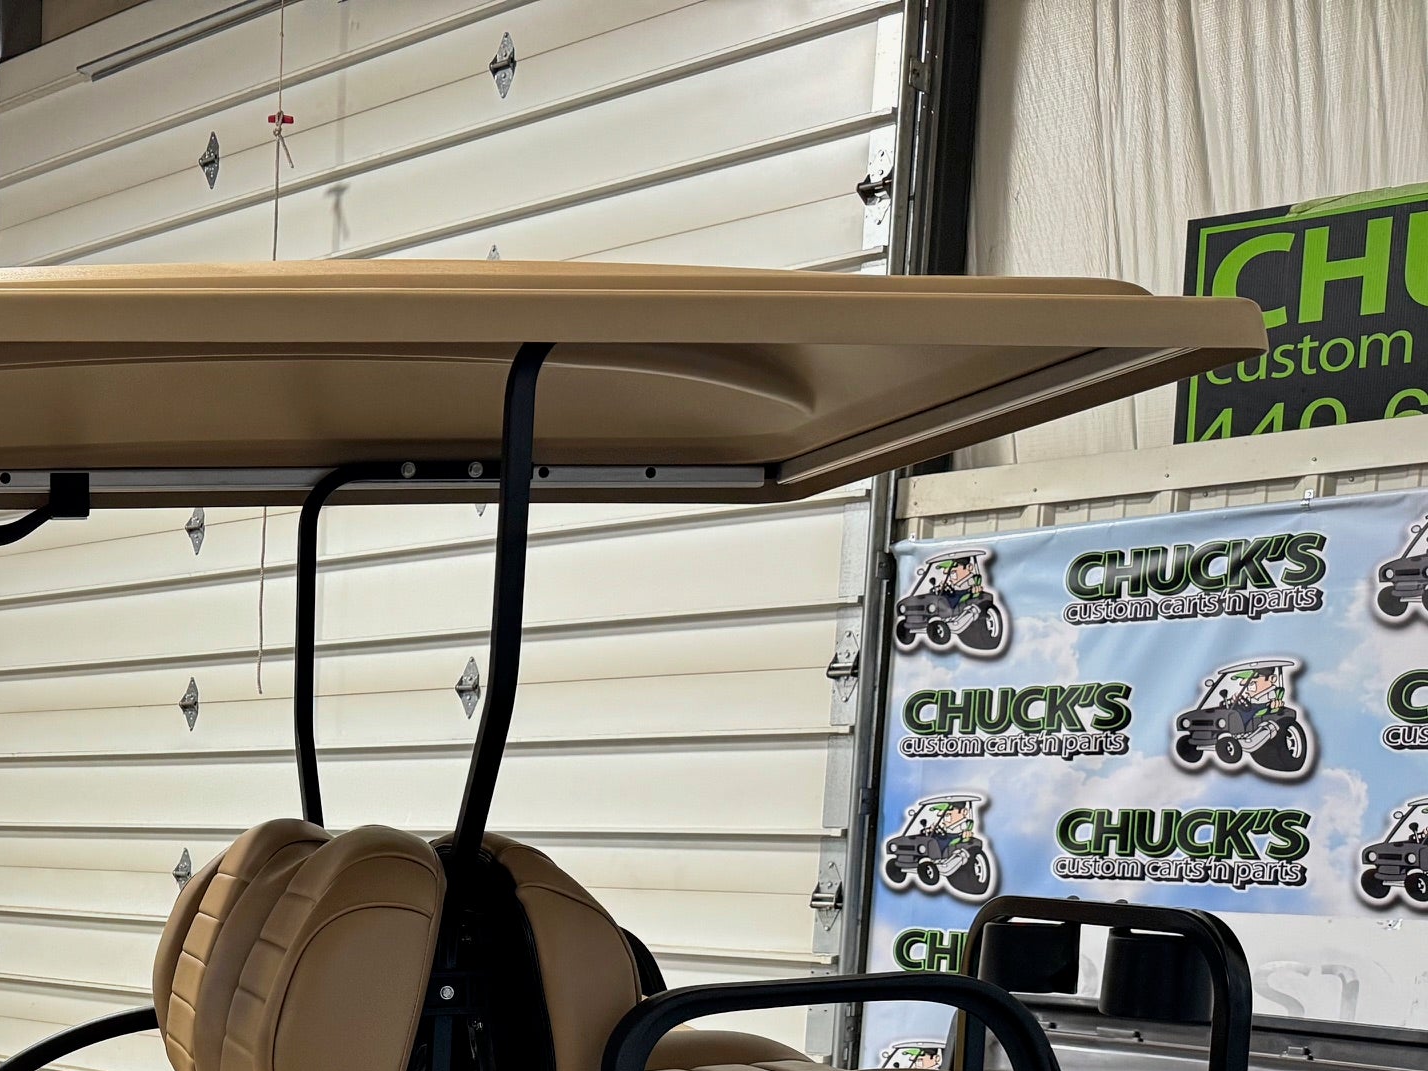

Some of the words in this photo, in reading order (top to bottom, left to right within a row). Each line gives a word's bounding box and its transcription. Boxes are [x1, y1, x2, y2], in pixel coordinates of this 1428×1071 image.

[1065, 532, 1327, 600] CHUCK'S
[1063, 599, 1155, 625] custom
[1248, 585, 1322, 619] parts
[902, 681, 1133, 735] CHUCK'S
[900, 735, 982, 758] custom
[1062, 731, 1129, 761] parts
[1056, 807, 1312, 861] CHUCK'S
[1054, 855, 1143, 879] custom
[1233, 860, 1308, 890] parts
[893, 930, 969, 973] CH
